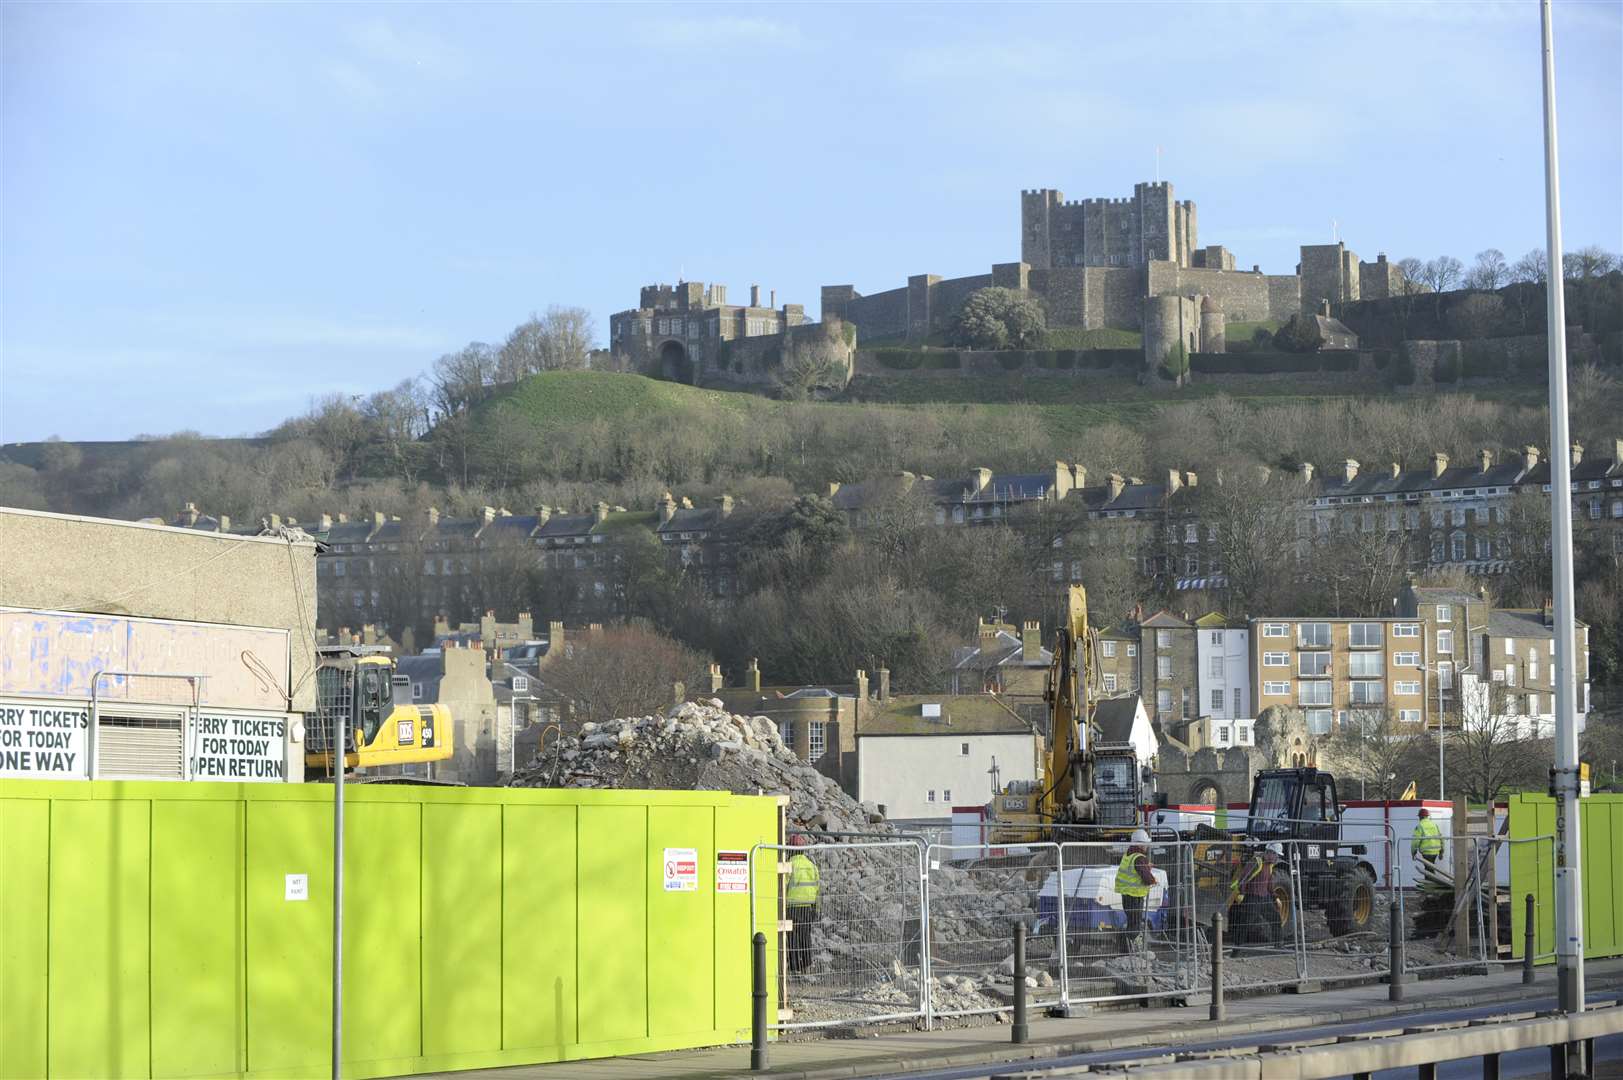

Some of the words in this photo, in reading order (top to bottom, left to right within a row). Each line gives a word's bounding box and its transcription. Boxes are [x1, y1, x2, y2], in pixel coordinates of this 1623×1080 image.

[30, 710, 88, 729] TICKETS
[232, 720, 284, 737] TICKETS
[0, 730, 21, 747] OR
[27, 731, 72, 749] TODAY
[422, 728, 432, 739] 450
[203, 738, 227, 754] FOR
[230, 739, 269, 756] TODAY
[35, 752, 76, 771] WAY
[229, 759, 283, 778] RETURN
